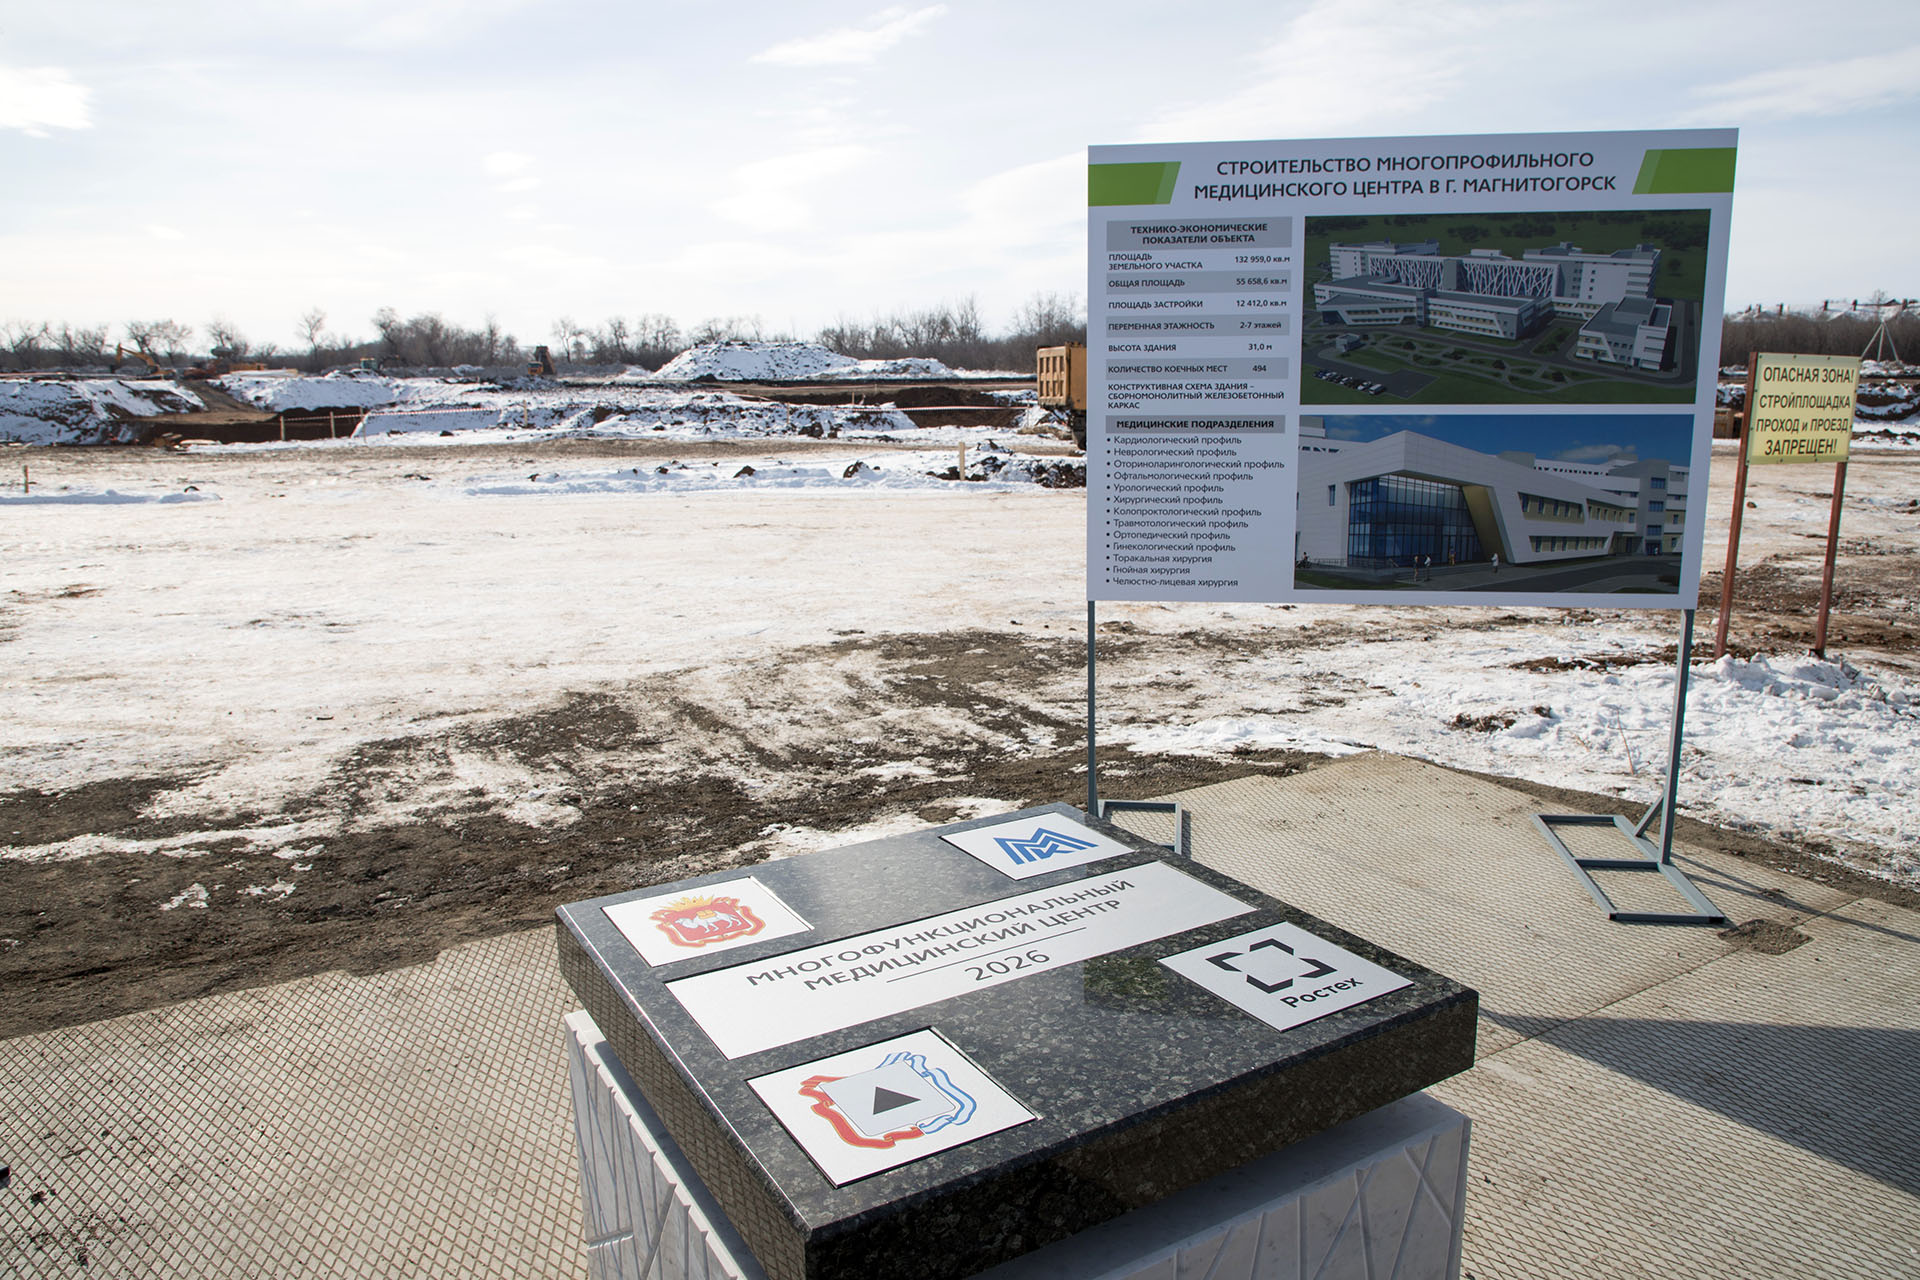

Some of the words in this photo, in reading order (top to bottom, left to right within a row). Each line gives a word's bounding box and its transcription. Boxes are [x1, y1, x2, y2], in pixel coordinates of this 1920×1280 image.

[1216, 157, 1371, 175] СТРОИТЕЛЬСТВО
[1376, 152, 1594, 171] МНОГОПРОФИЛЬНОГО
[1194, 182, 1348, 201] МЕДИЦИНСКОГО
[1353, 179, 1424, 198] ЦЕНТРА
[1429, 179, 1440, 193] В
[1446, 179, 1457, 193] Г.
[1463, 175, 1616, 193] МАГНИТОГОРСК
[1131, 223, 1268, 234] ТЕХНИКО-ЭКОНОМИЧЕСКИЕ
[1143, 235, 1208, 245] ПОКАЗАТЕЛИ
[1211, 235, 1255, 243] ОБЪЕКТА
[1108, 254, 1152, 262] ПЛОЩАДЬ
[1154, 300, 1203, 308] ЗАСТРОЙКИ
[1108, 323, 1161, 331] ПЕРЕМЕННАЯ
[1163, 322, 1214, 330] ЭТАЖНОСТЬ
[1253, 321, 1281, 329] этажей
[1144, 344, 1176, 352] ЗДАНИЯ
[1248, 343, 1264, 351] 31,0
[1165, 365, 1204, 373] КОЕЧНЫХ
[1763, 367, 1819, 382] ОПАСНАЯ
[1822, 368, 1854, 383] ЗОНА!
[1215, 383, 1248, 391] ЗДАНИЯ
[1108, 392, 1202, 400] СБОРНОМОНОЛИТНЫЙ
[1205, 391, 1284, 399] ЖЕЛЕЗОБЕТОННЫЙ
[1759, 392, 1850, 411] СТРОЙПЛОЩАДКА
[1116, 421, 1189, 429] МЕДИЦИНСКИЕ
[1191, 421, 1274, 429] ПОДРАЗДЕЛЕНИЯ
[1756, 419, 1799, 433] ПРОХОД
[1802, 421, 1808, 431] и
[1810, 418, 1848, 433] ПРОЕЗД
[1114, 436, 1199, 445] Кардиологический
[1202, 437, 1242, 445] профиль
[1114, 448, 1194, 457] Неврологический
[1197, 448, 1237, 457] профиль
[1765, 439, 1837, 457] ЗАПРЕЩЕН!
[1114, 460, 1241, 468] Оториноларингологический
[1244, 461, 1285, 469] профиль
[1114, 472, 1211, 481] Офтальмологический
[1213, 472, 1253, 481] профиль
[1114, 484, 1181, 493] Урологический
[1184, 484, 1224, 493] профиль
[1114, 496, 1180, 505] Хирургический
[1183, 496, 1223, 505] профиль
[1113, 508, 1219, 516] Колопроктологический
[1221, 508, 1262, 517] профиль
[1209, 520, 1249, 529] профиль
[1113, 531, 1188, 539] Ортопедический
[1190, 532, 1231, 540] профиль
[1113, 542, 1193, 551] Гинекологический
[1196, 543, 1236, 552] профиль
[1113, 554, 1170, 562] Торакальная
[1113, 566, 1148, 574] Гнойная
[1150, 567, 1190, 575] хирургия
[1113, 577, 1195, 586] Челюстно-лицевая
[1198, 579, 1238, 587] хирургия
[746, 879, 1135, 986] МНОГОФУНКЦИОНАЛЬНЫЙ
[802, 922, 1037, 991] МЕДИЦИНСКИЙ
[1043, 899, 1121, 932] ЦЕНТР
[965, 949, 1050, 981] 2026
[1280, 977, 1364, 1008] Ростех
